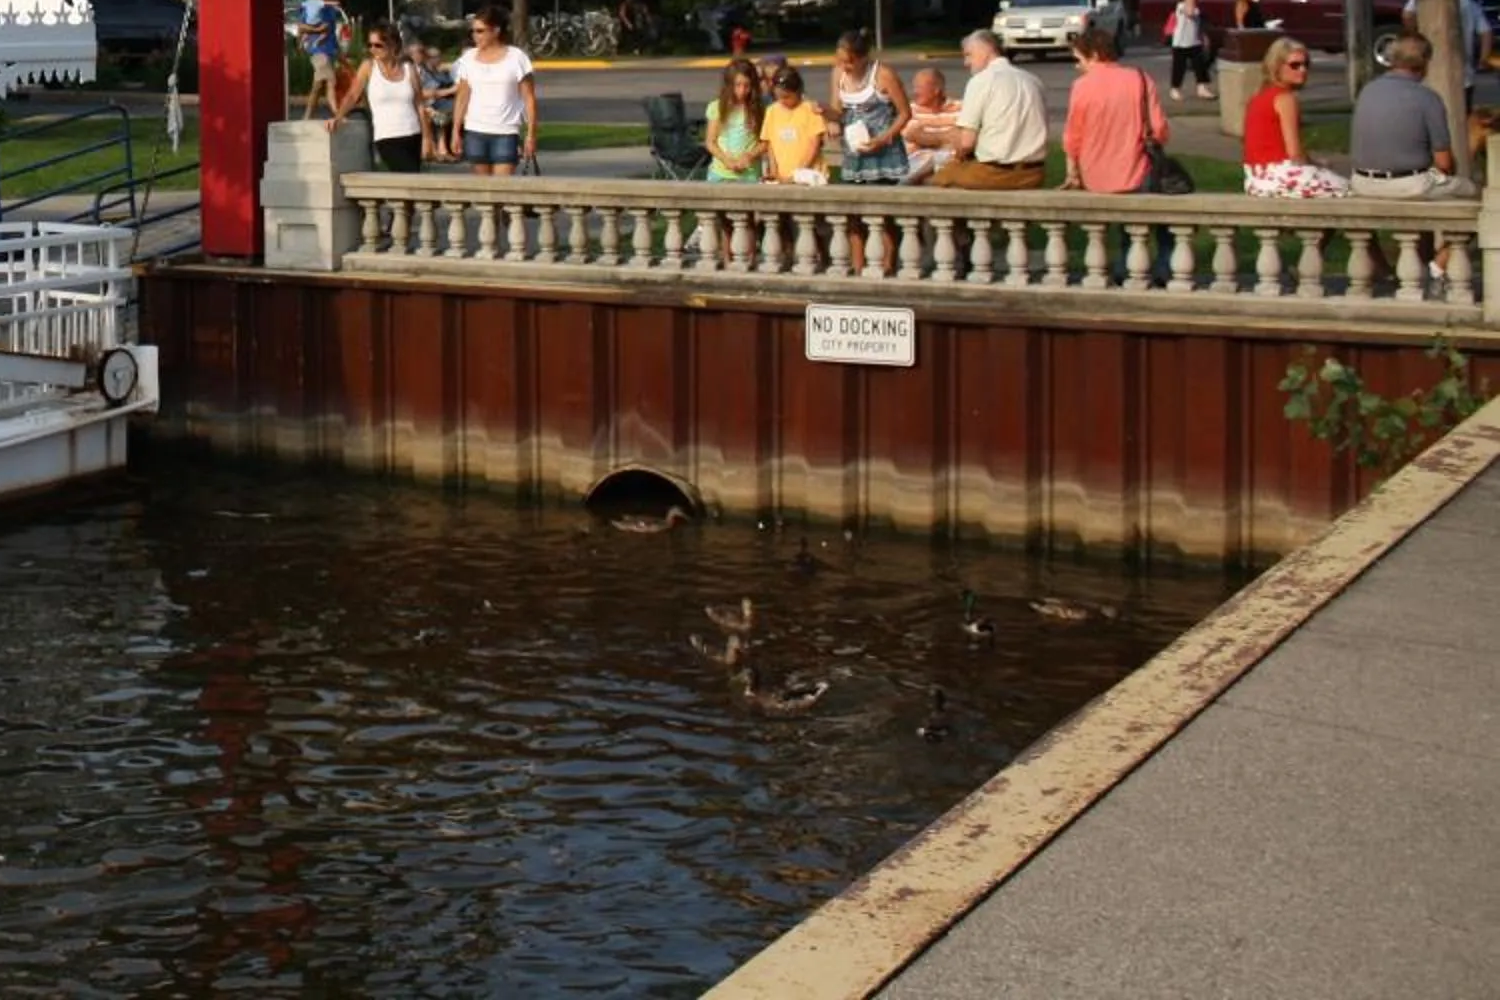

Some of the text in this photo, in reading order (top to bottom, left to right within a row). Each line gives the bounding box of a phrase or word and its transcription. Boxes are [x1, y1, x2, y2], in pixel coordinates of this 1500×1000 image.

[812, 315, 908, 338] NO DOCKING
[821, 339, 897, 354] CITY PROPERTY
